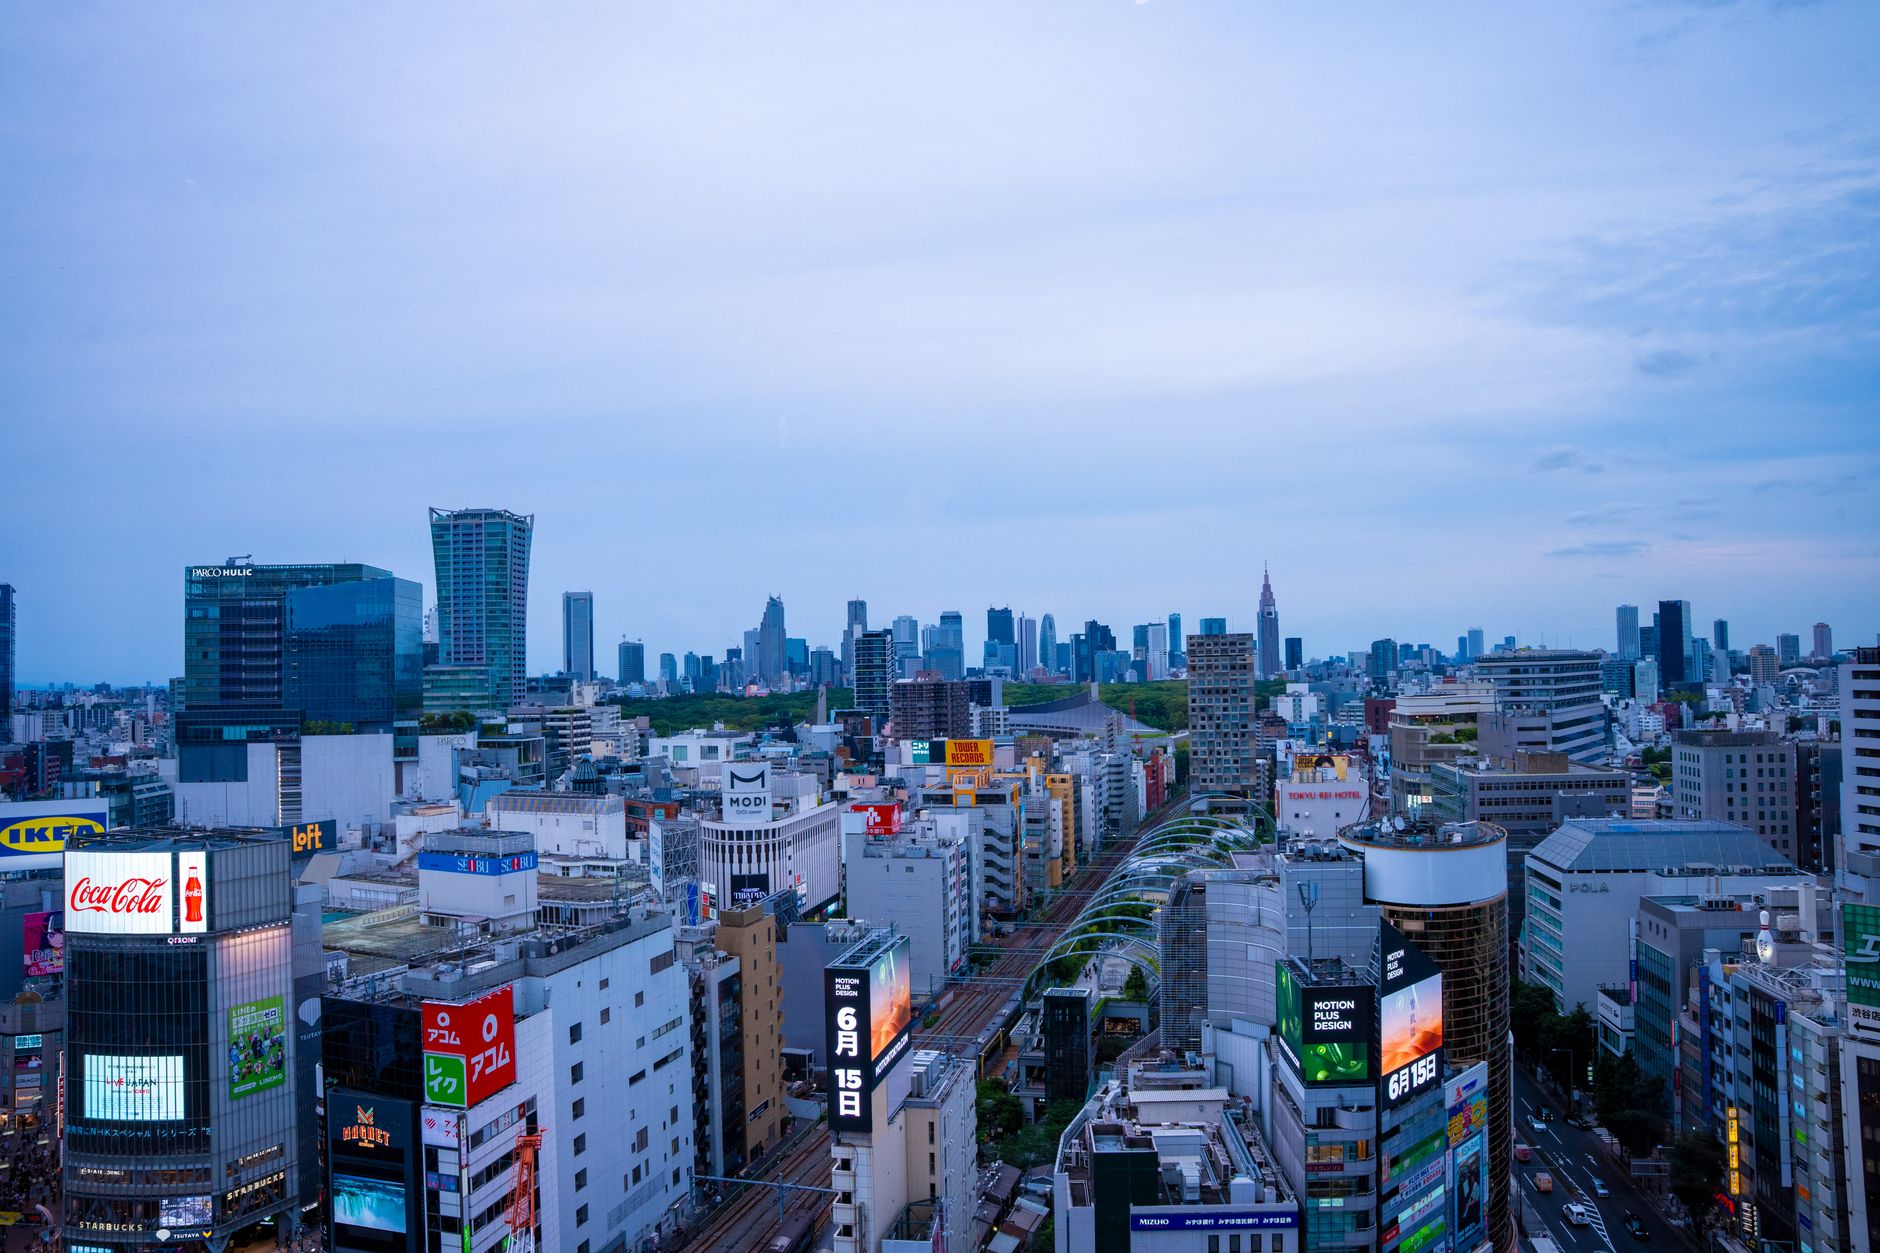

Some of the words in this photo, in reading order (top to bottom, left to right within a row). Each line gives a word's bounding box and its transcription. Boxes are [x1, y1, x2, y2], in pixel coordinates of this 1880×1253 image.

[192, 568, 221, 577] PARCO
[223, 568, 252, 576] HULIC
[437, 737, 466, 745] PARCO
[954, 742, 979, 753] TOWER
[951, 753, 985, 763] RECORDS
[1288, 792, 1316, 800] TOKYU
[1334, 791, 1361, 799] HOTEL
[730, 796, 766, 807] MODI
[9, 824, 97, 844] IKEA
[457, 858, 489, 873] SEIBU
[501, 855, 533, 873] SEIBU
[1570, 882, 1609, 893] POLA
[71, 877, 168, 913] Coca-Cola
[1387, 949, 1405, 963] MOTION
[1387, 960, 1399, 972] PLUS
[1387, 967, 1404, 981] DESIGN
[1314, 1000, 1355, 1010] MOTION
[1314, 1011, 1340, 1020] PLUS
[1314, 1021, 1352, 1031] DESIGN
[427, 1029, 460, 1045] アコム
[470, 1041, 511, 1083] アコム
[126, 1078, 156, 1088] JAPAN
[343, 1125, 390, 1146] MAGNET
[227, 1171, 285, 1200] STARBUCKS
[79, 1221, 143, 1232] STARBUCKS
